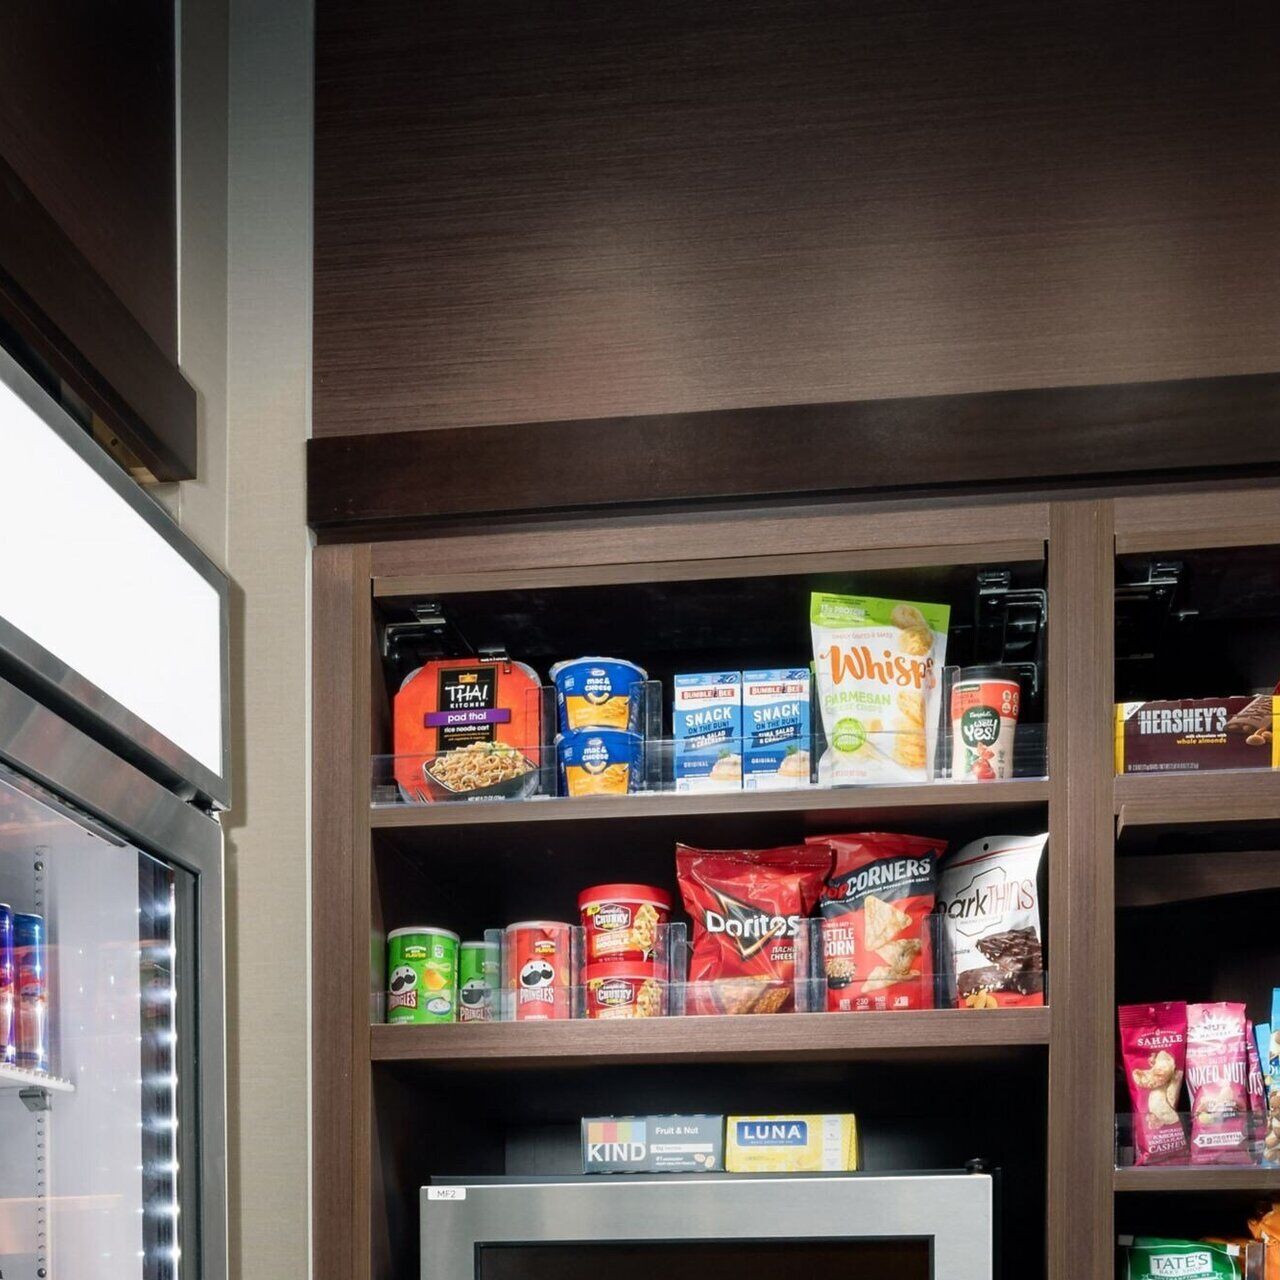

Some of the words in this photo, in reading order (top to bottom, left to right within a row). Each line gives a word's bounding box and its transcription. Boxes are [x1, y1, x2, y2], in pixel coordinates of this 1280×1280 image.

[819, 645, 936, 689] Whisps
[445, 684, 488, 702] THAI
[684, 691, 712, 699] BUMBLE
[719, 689, 732, 697] BEE
[825, 689, 892, 706] PARMESAN
[448, 713, 467, 723] pad
[469, 712, 487, 720] thai
[686, 707, 732, 726] SNACK
[754, 703, 800, 722] SNACK
[1138, 707, 1228, 735] HERSHEY'S
[595, 910, 628, 928] CHUNKY
[706, 910, 800, 938] Doritos
[520, 987, 554, 1004] PRINGLES
[598, 987, 633, 1002] CHUNKY
[1137, 1035, 1184, 1046] SAHALE
[655, 1127, 675, 1135] Fruit
[683, 1126, 699, 1134] Nut
[743, 1125, 801, 1139] LUNA
[588, 1143, 646, 1162] KIND
[436, 1190, 456, 1198] MF2
[1153, 1254, 1209, 1270] TATE'S
